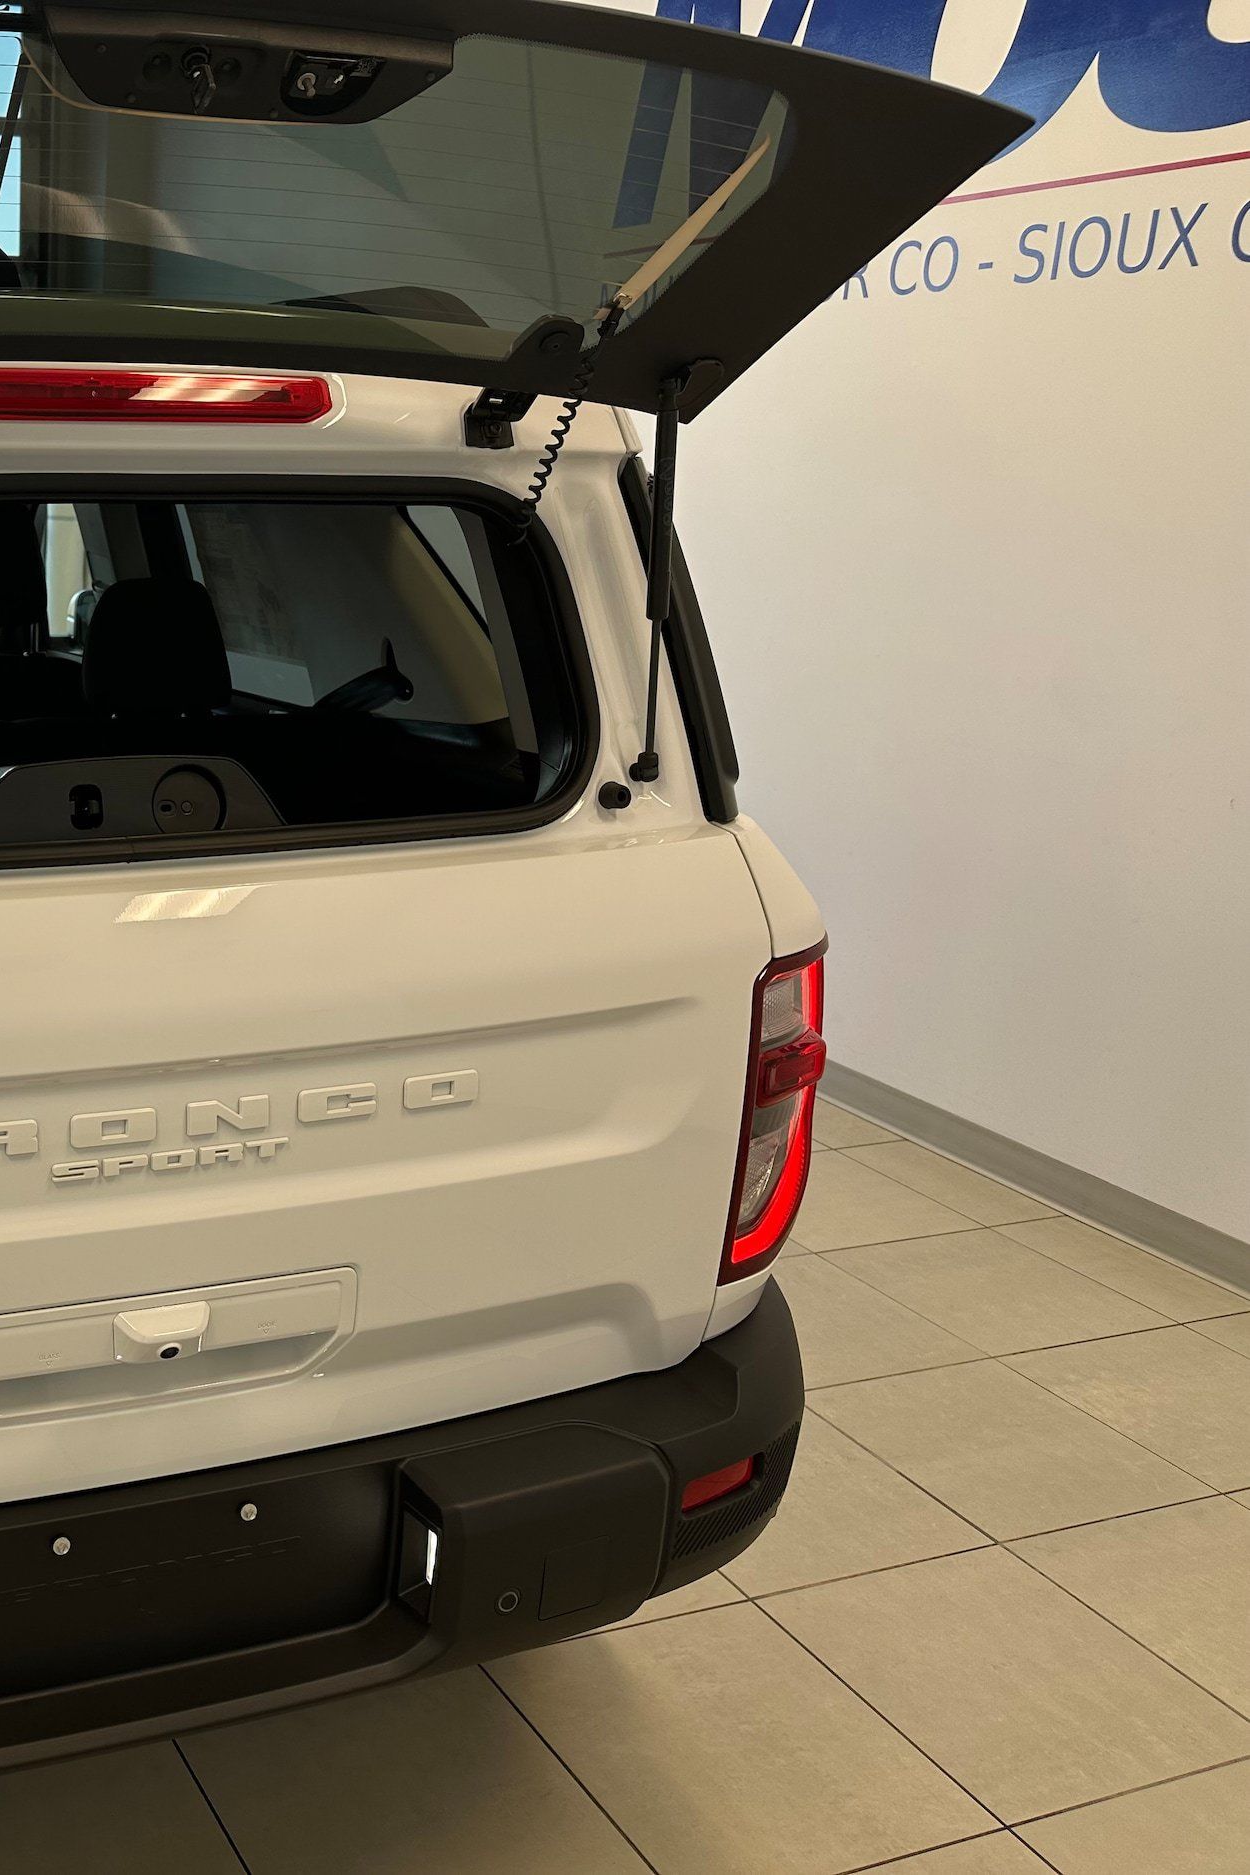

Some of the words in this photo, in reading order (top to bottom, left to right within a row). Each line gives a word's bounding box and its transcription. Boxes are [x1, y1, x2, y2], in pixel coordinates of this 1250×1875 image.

[890, 235, 959, 296] CO
[1013, 202, 1210, 284] SIOUX
[50, 1135, 290, 1183] SPORT
